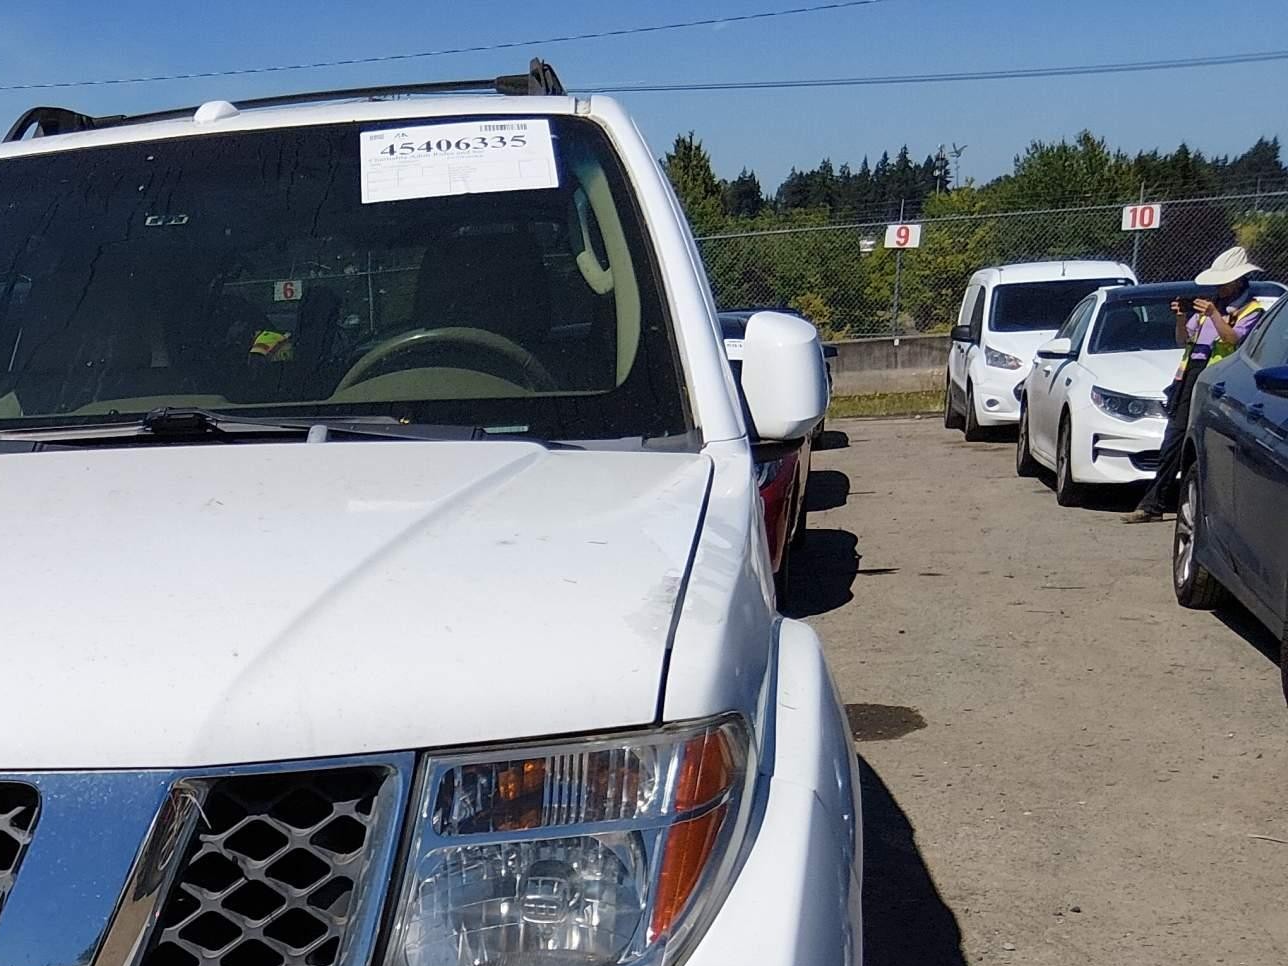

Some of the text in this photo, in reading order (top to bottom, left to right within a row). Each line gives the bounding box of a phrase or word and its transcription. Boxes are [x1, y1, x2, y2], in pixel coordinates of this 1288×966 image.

[380, 134, 527, 156] 45406335
[1129, 206, 1154, 228] 10
[895, 226, 910, 247] 9
[283, 282, 294, 299] 6
